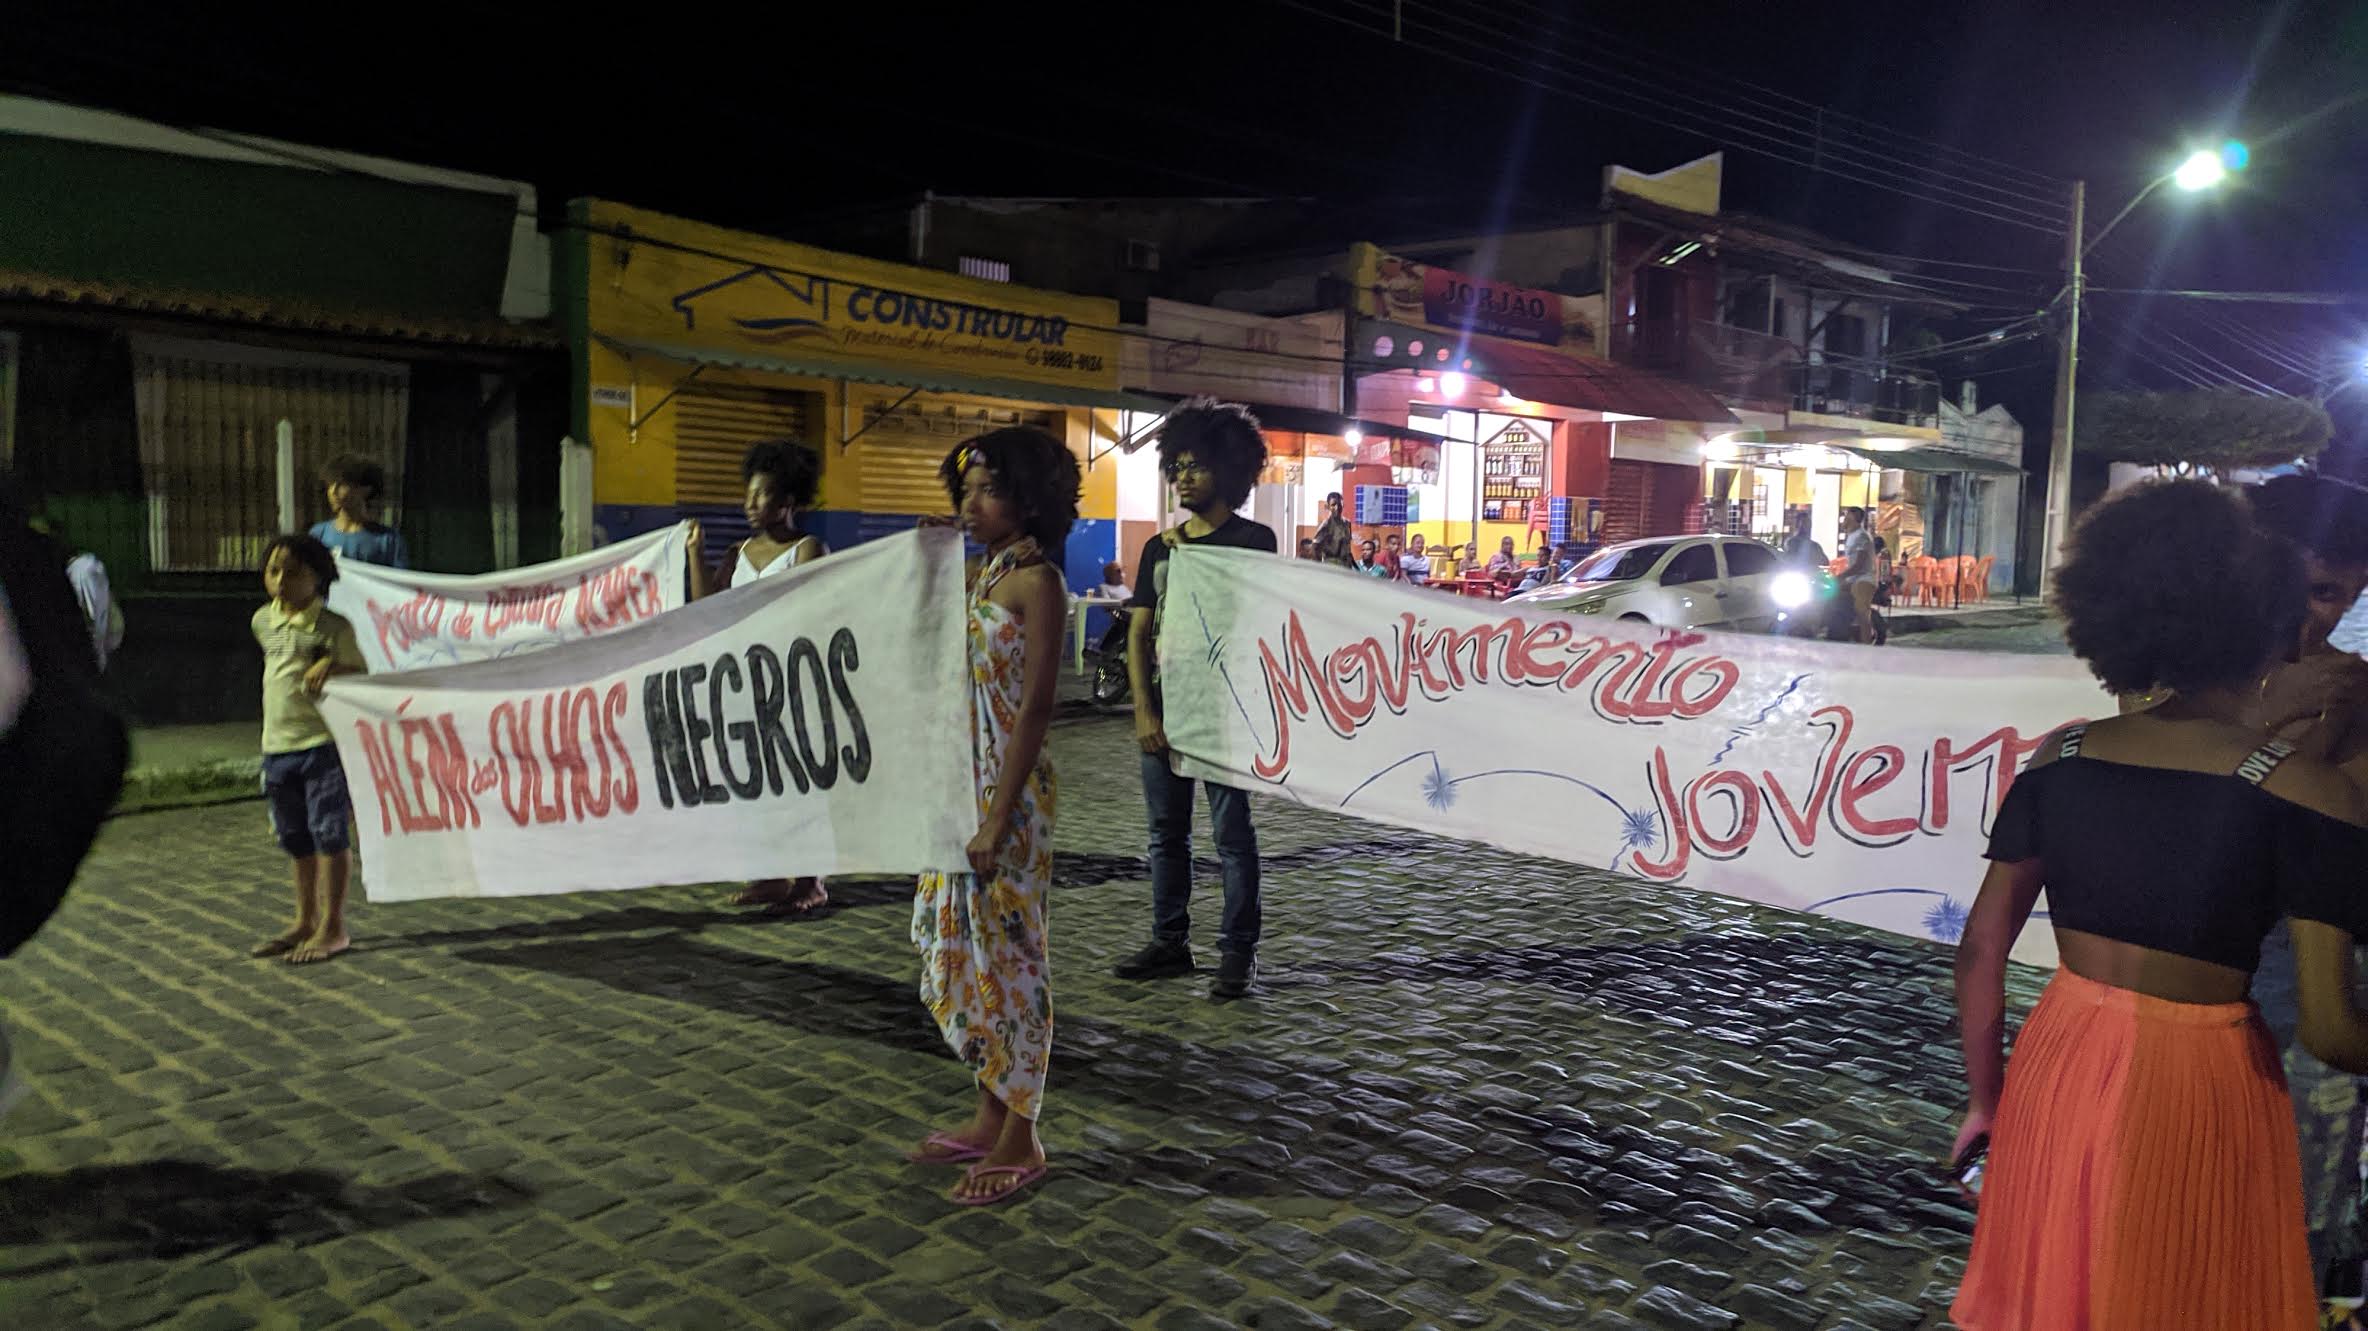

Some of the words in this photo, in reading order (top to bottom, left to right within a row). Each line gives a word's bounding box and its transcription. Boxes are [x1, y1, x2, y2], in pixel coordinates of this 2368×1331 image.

[847, 286, 1068, 347] CONSTRULAR
[451, 600, 475, 641] de
[355, 696, 481, 837] ALÉM
[470, 757, 498, 796] dos
[488, 681, 640, 828] OLHOS
[643, 626, 872, 810] NEGROS
